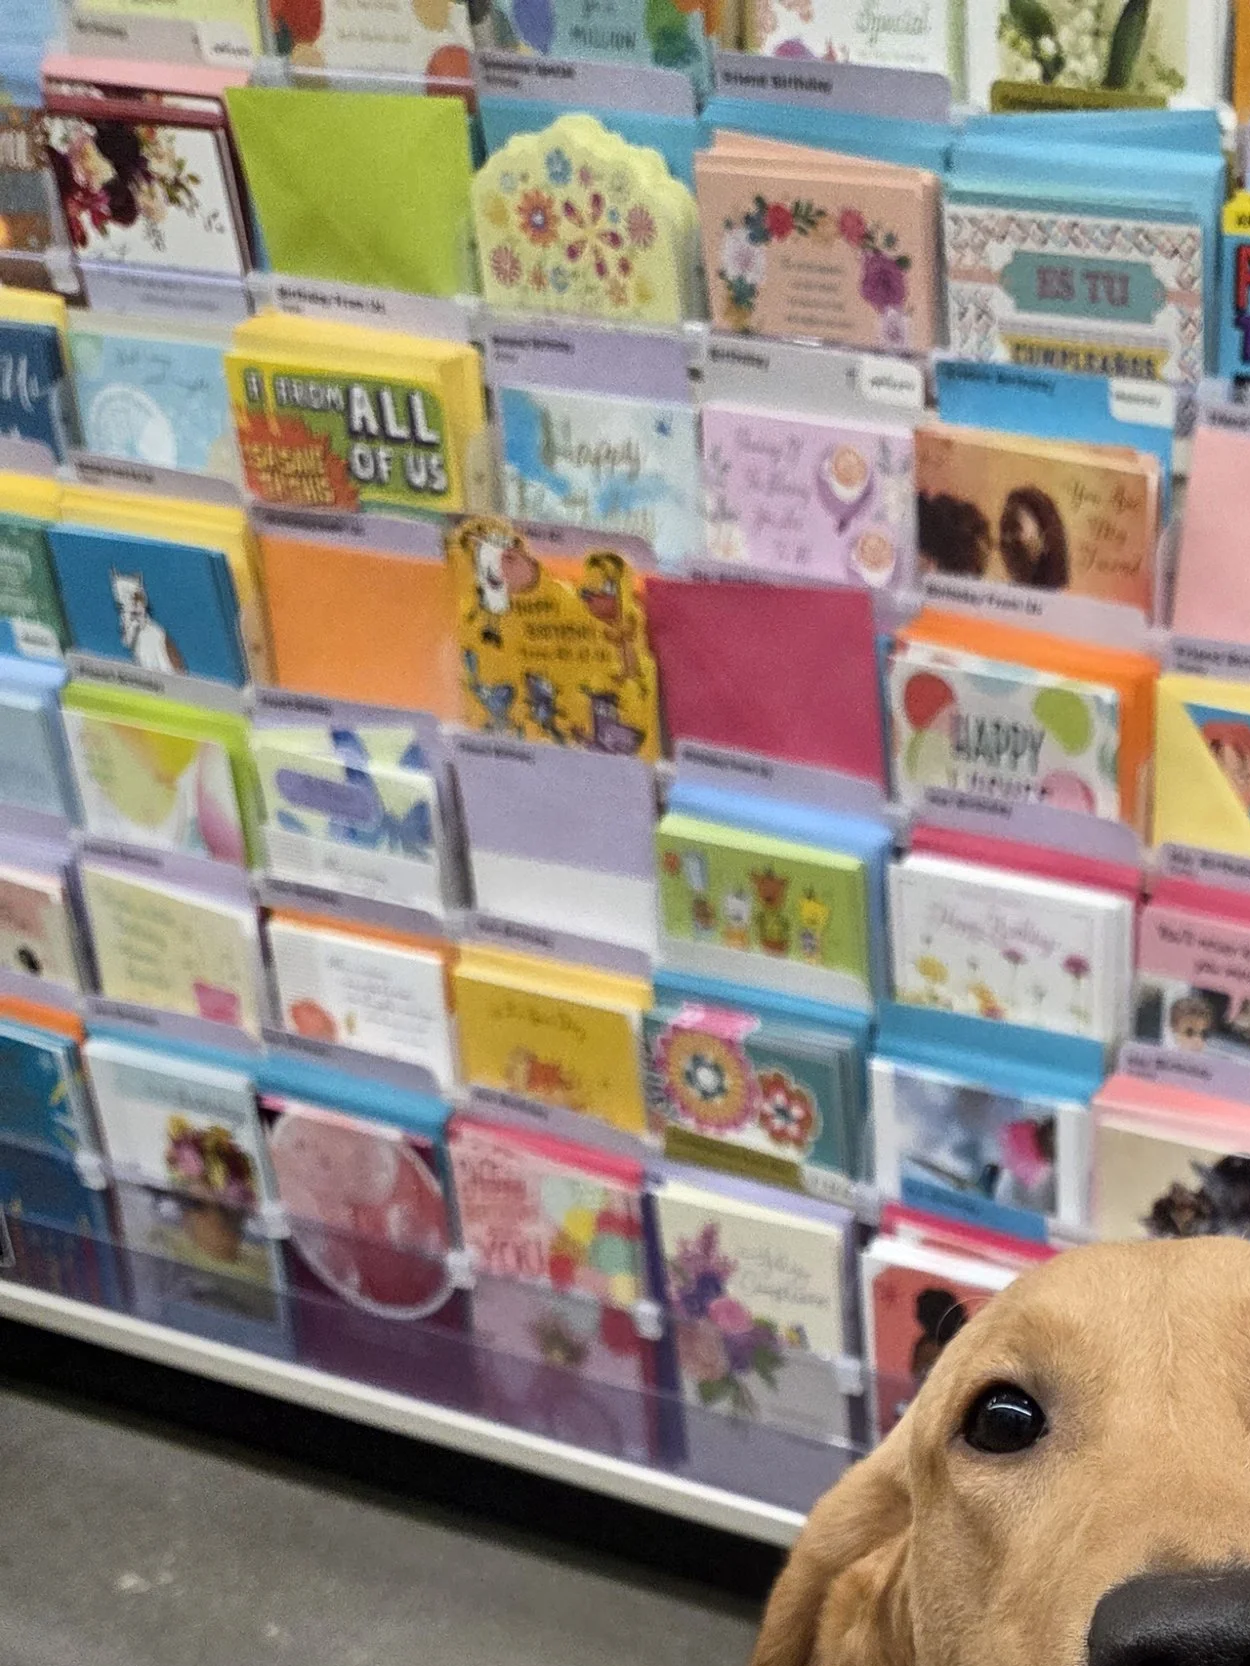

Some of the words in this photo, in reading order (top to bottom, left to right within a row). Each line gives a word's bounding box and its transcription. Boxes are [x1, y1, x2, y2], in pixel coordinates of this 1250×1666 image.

[348, 382, 442, 446] ALL
[351, 441, 394, 484] OF
[403, 449, 449, 493] US
